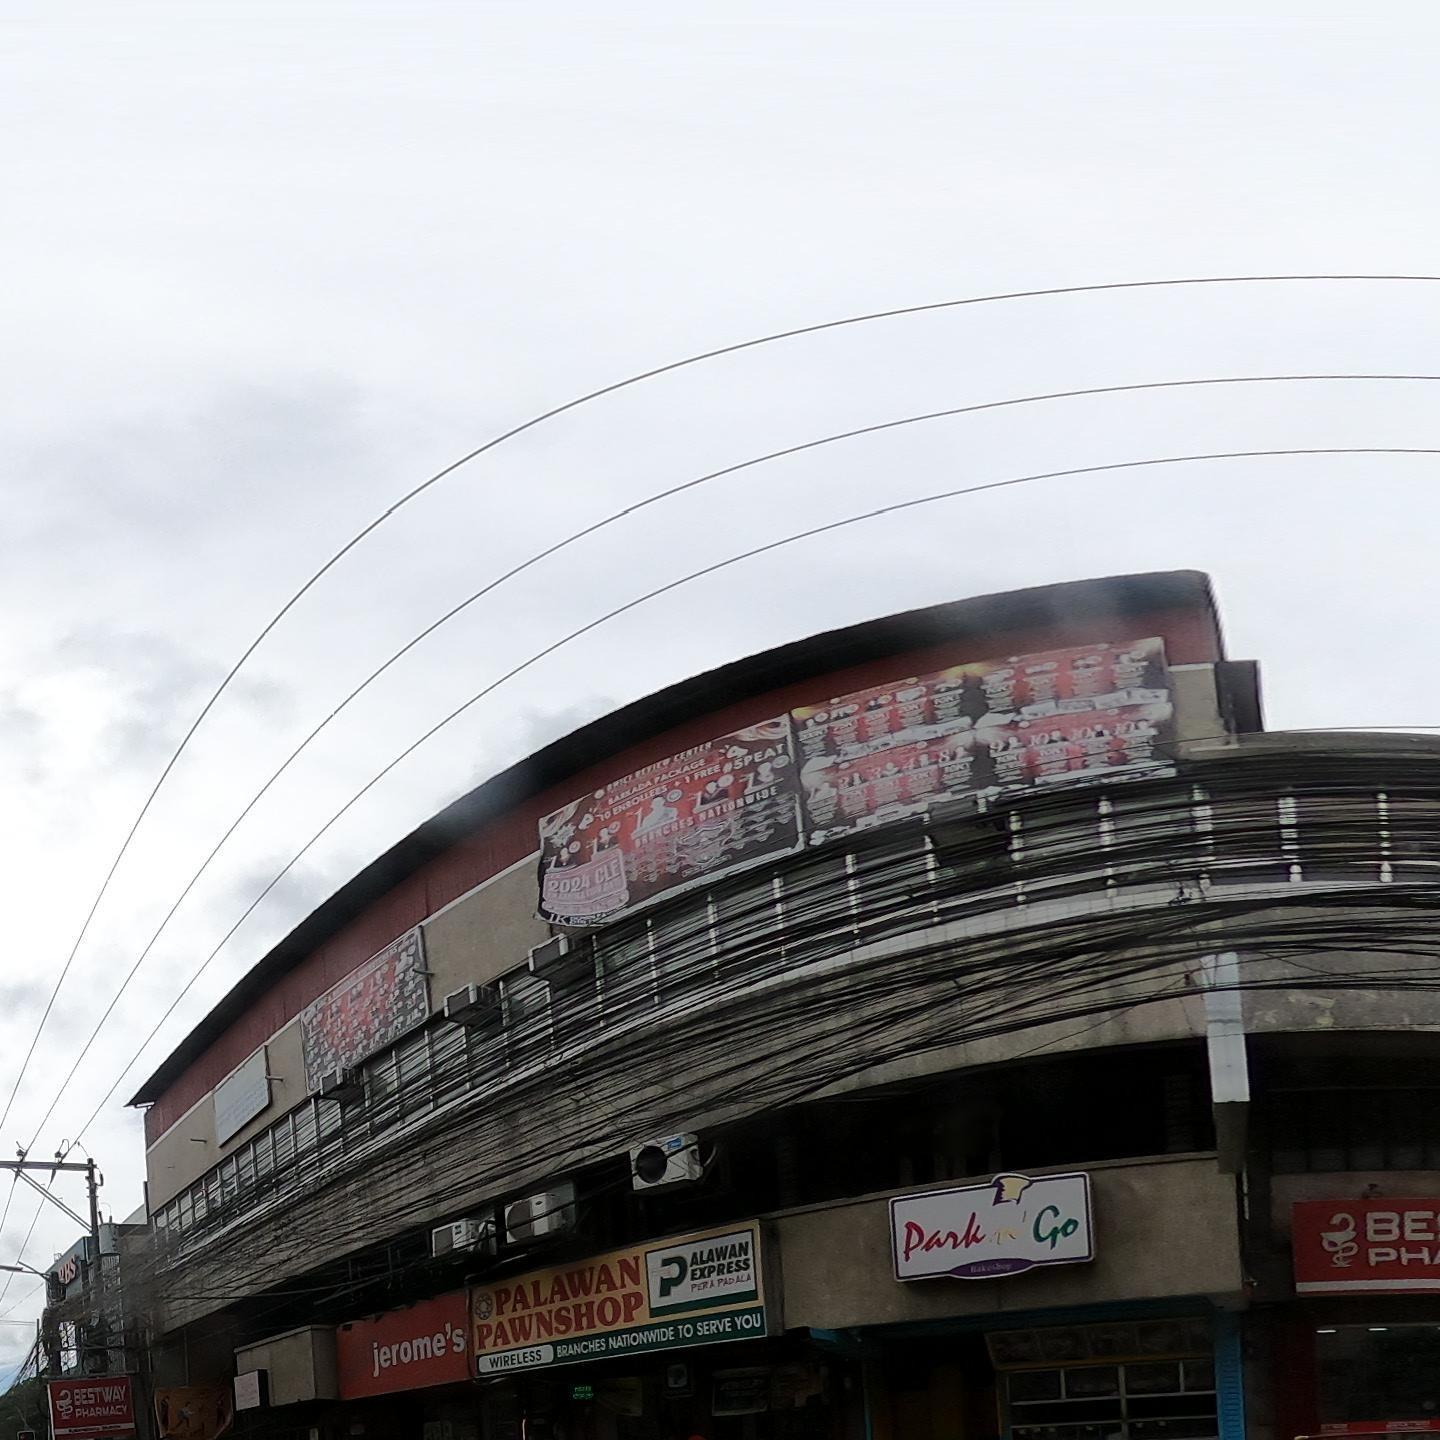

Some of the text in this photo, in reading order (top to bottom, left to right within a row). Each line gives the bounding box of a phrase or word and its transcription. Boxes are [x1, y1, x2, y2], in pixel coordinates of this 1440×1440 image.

[654, 758, 706, 784] PACKAGE
[693, 764, 721, 781] FREE
[903, 1211, 986, 1262] Park
[1032, 1204, 1080, 1250] Go
[690, 1258, 751, 1282] EXPRESS
[690, 1273, 752, 1293] PERA PADALA
[495, 1255, 641, 1317] PALAWAN
[476, 1291, 645, 1350] PAWNSHOP
[372, 1322, 466, 1378] jerome's
[489, 1313, 762, 1369] WIRELESS BRANCHES NATIONWIDE TO SERVE YOU
[73, 1385, 127, 1406] BESTWAY
[75, 1405, 128, 1419] PHARMACY
